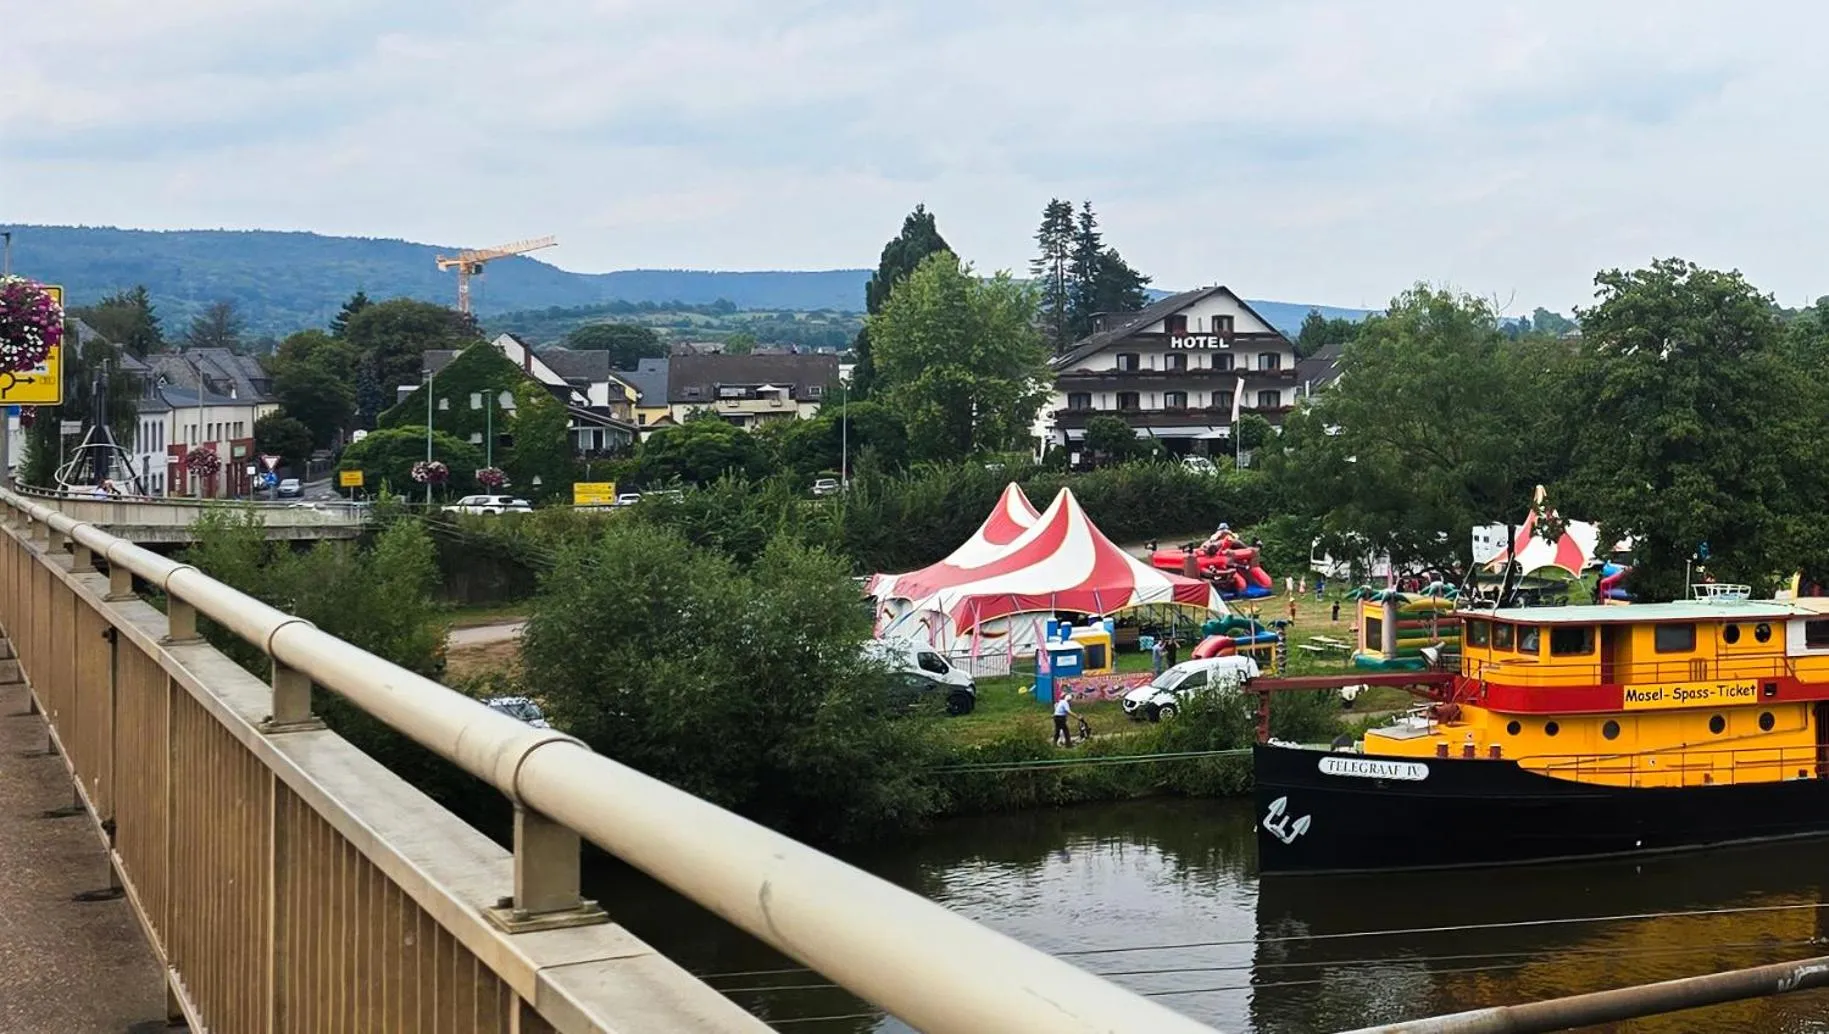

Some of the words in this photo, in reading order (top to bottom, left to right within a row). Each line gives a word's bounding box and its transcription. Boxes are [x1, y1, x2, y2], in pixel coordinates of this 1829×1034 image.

[1171, 336, 1230, 349] HOTEL
[1625, 684, 1756, 703] Mosel-Spass-Ticket
[1327, 760, 1401, 776] TELEGRAAF
